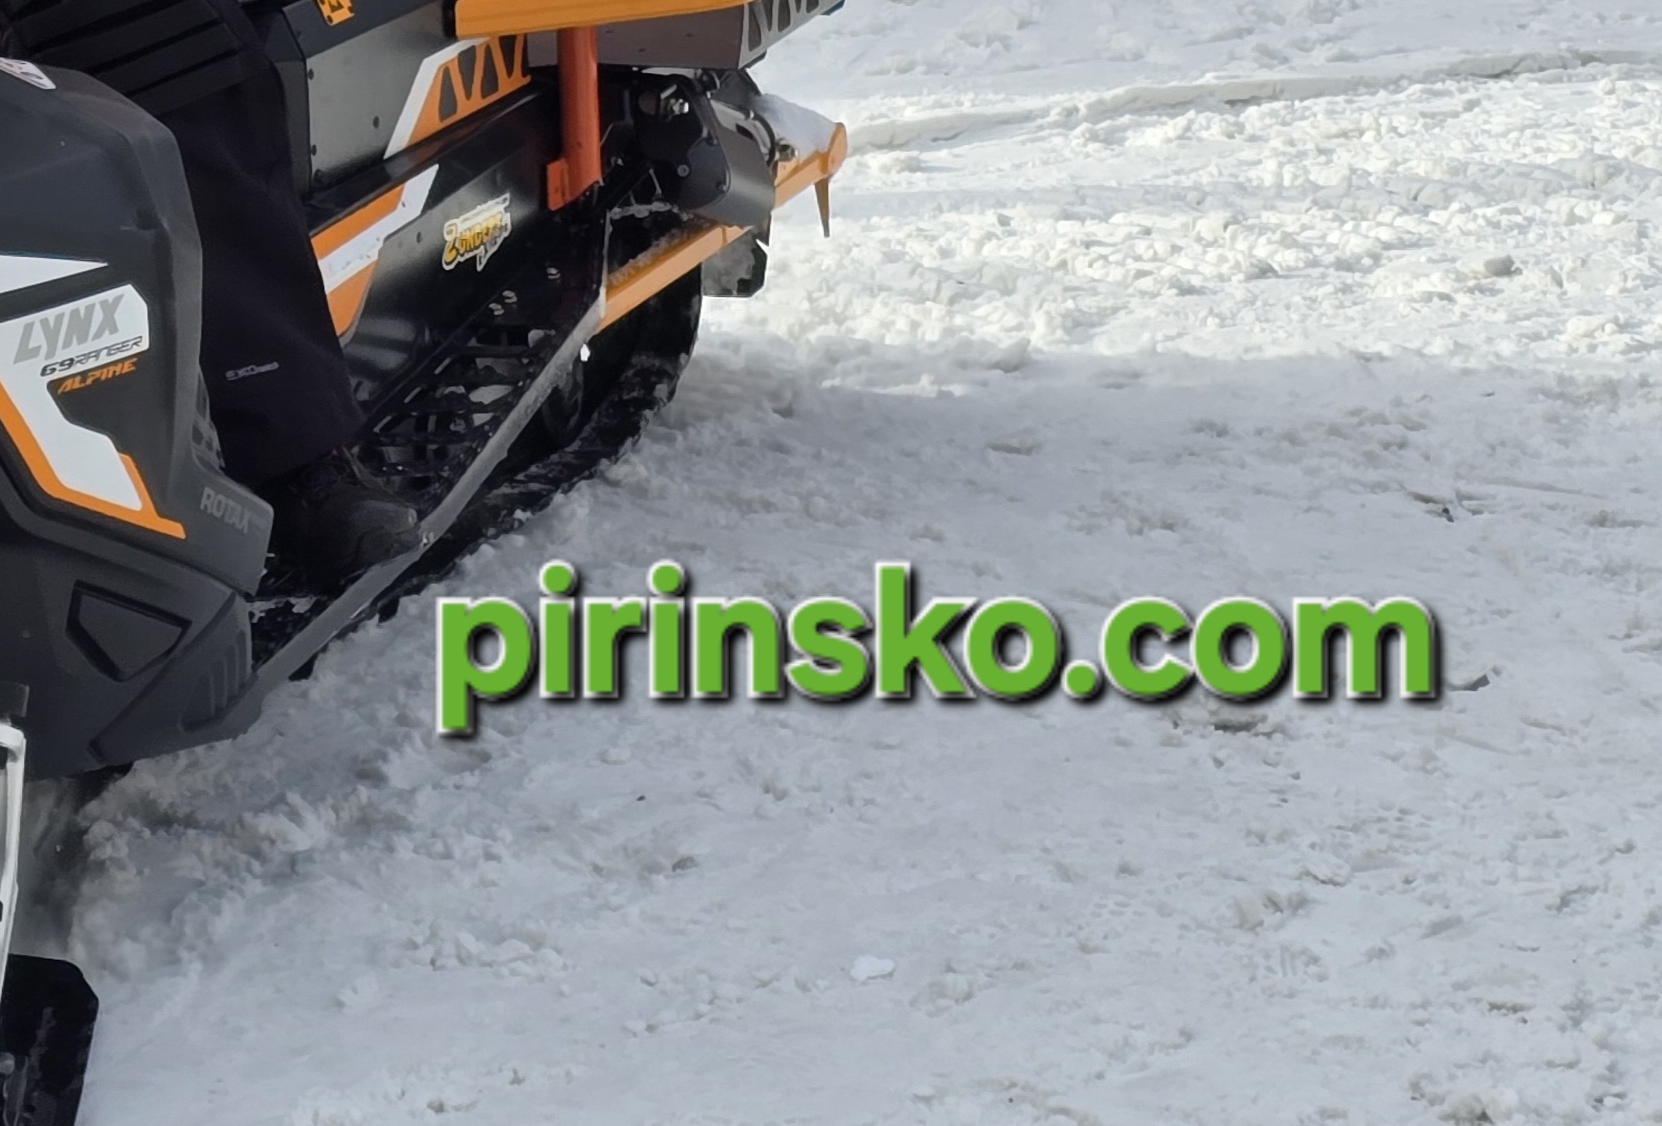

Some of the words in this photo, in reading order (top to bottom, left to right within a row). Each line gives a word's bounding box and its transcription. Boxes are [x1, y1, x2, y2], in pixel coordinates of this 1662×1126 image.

[12, 293, 125, 365] LYNX
[57, 358, 138, 395] ALPINE
[200, 486, 253, 535] ROTAX
